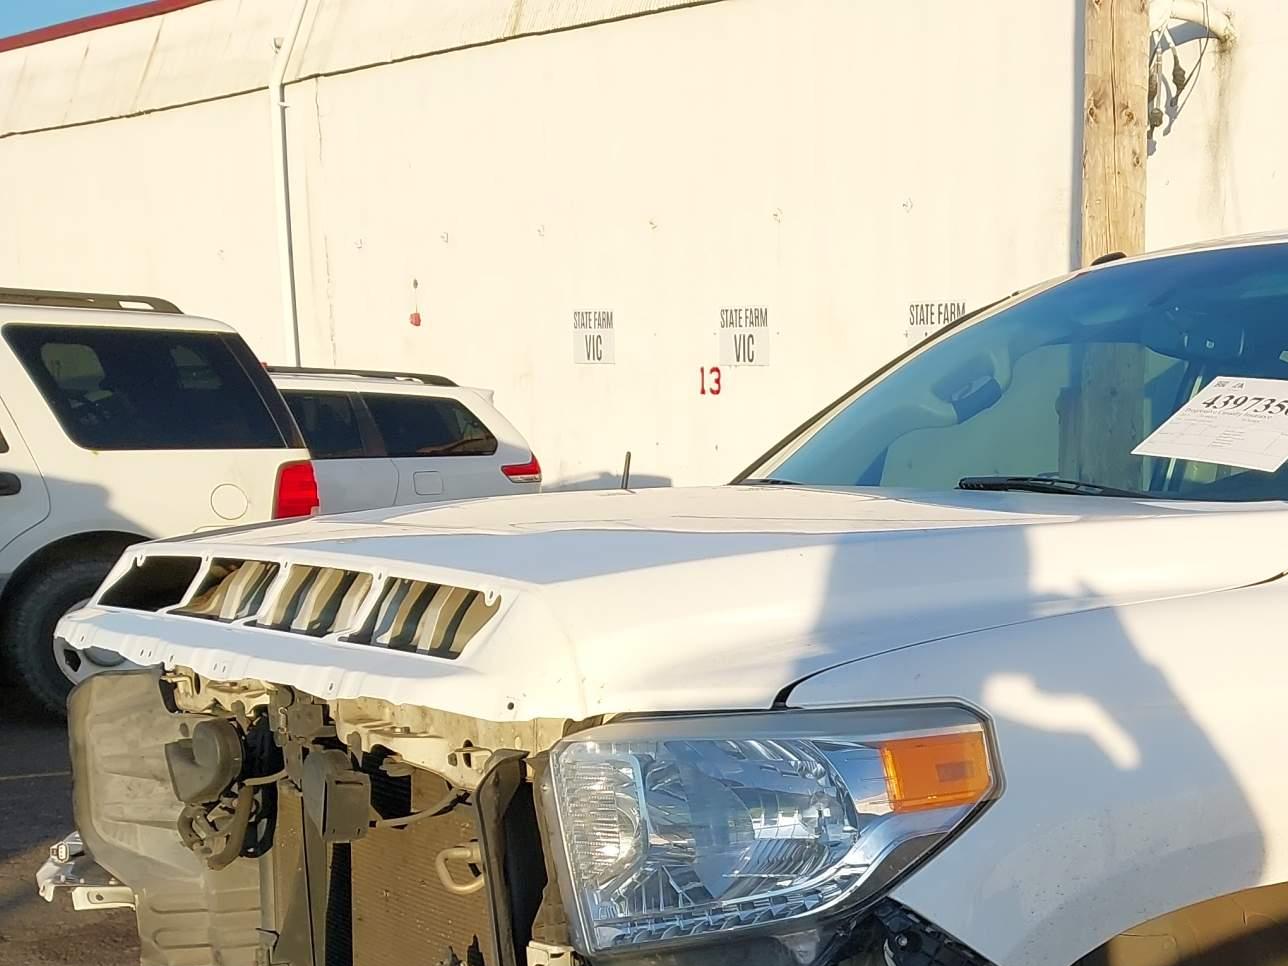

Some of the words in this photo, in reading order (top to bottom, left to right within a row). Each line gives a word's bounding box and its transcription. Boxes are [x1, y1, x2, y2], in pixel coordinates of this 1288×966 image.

[573, 311, 592, 329] STATE
[593, 311, 613, 329] FARM
[720, 309, 743, 328] STATE
[744, 308, 768, 328] FARM
[908, 303, 934, 326] STATE
[938, 302, 966, 325] FARM
[585, 334, 603, 361] VIC
[734, 334, 754, 362] VIC
[700, 366, 721, 395] 13
